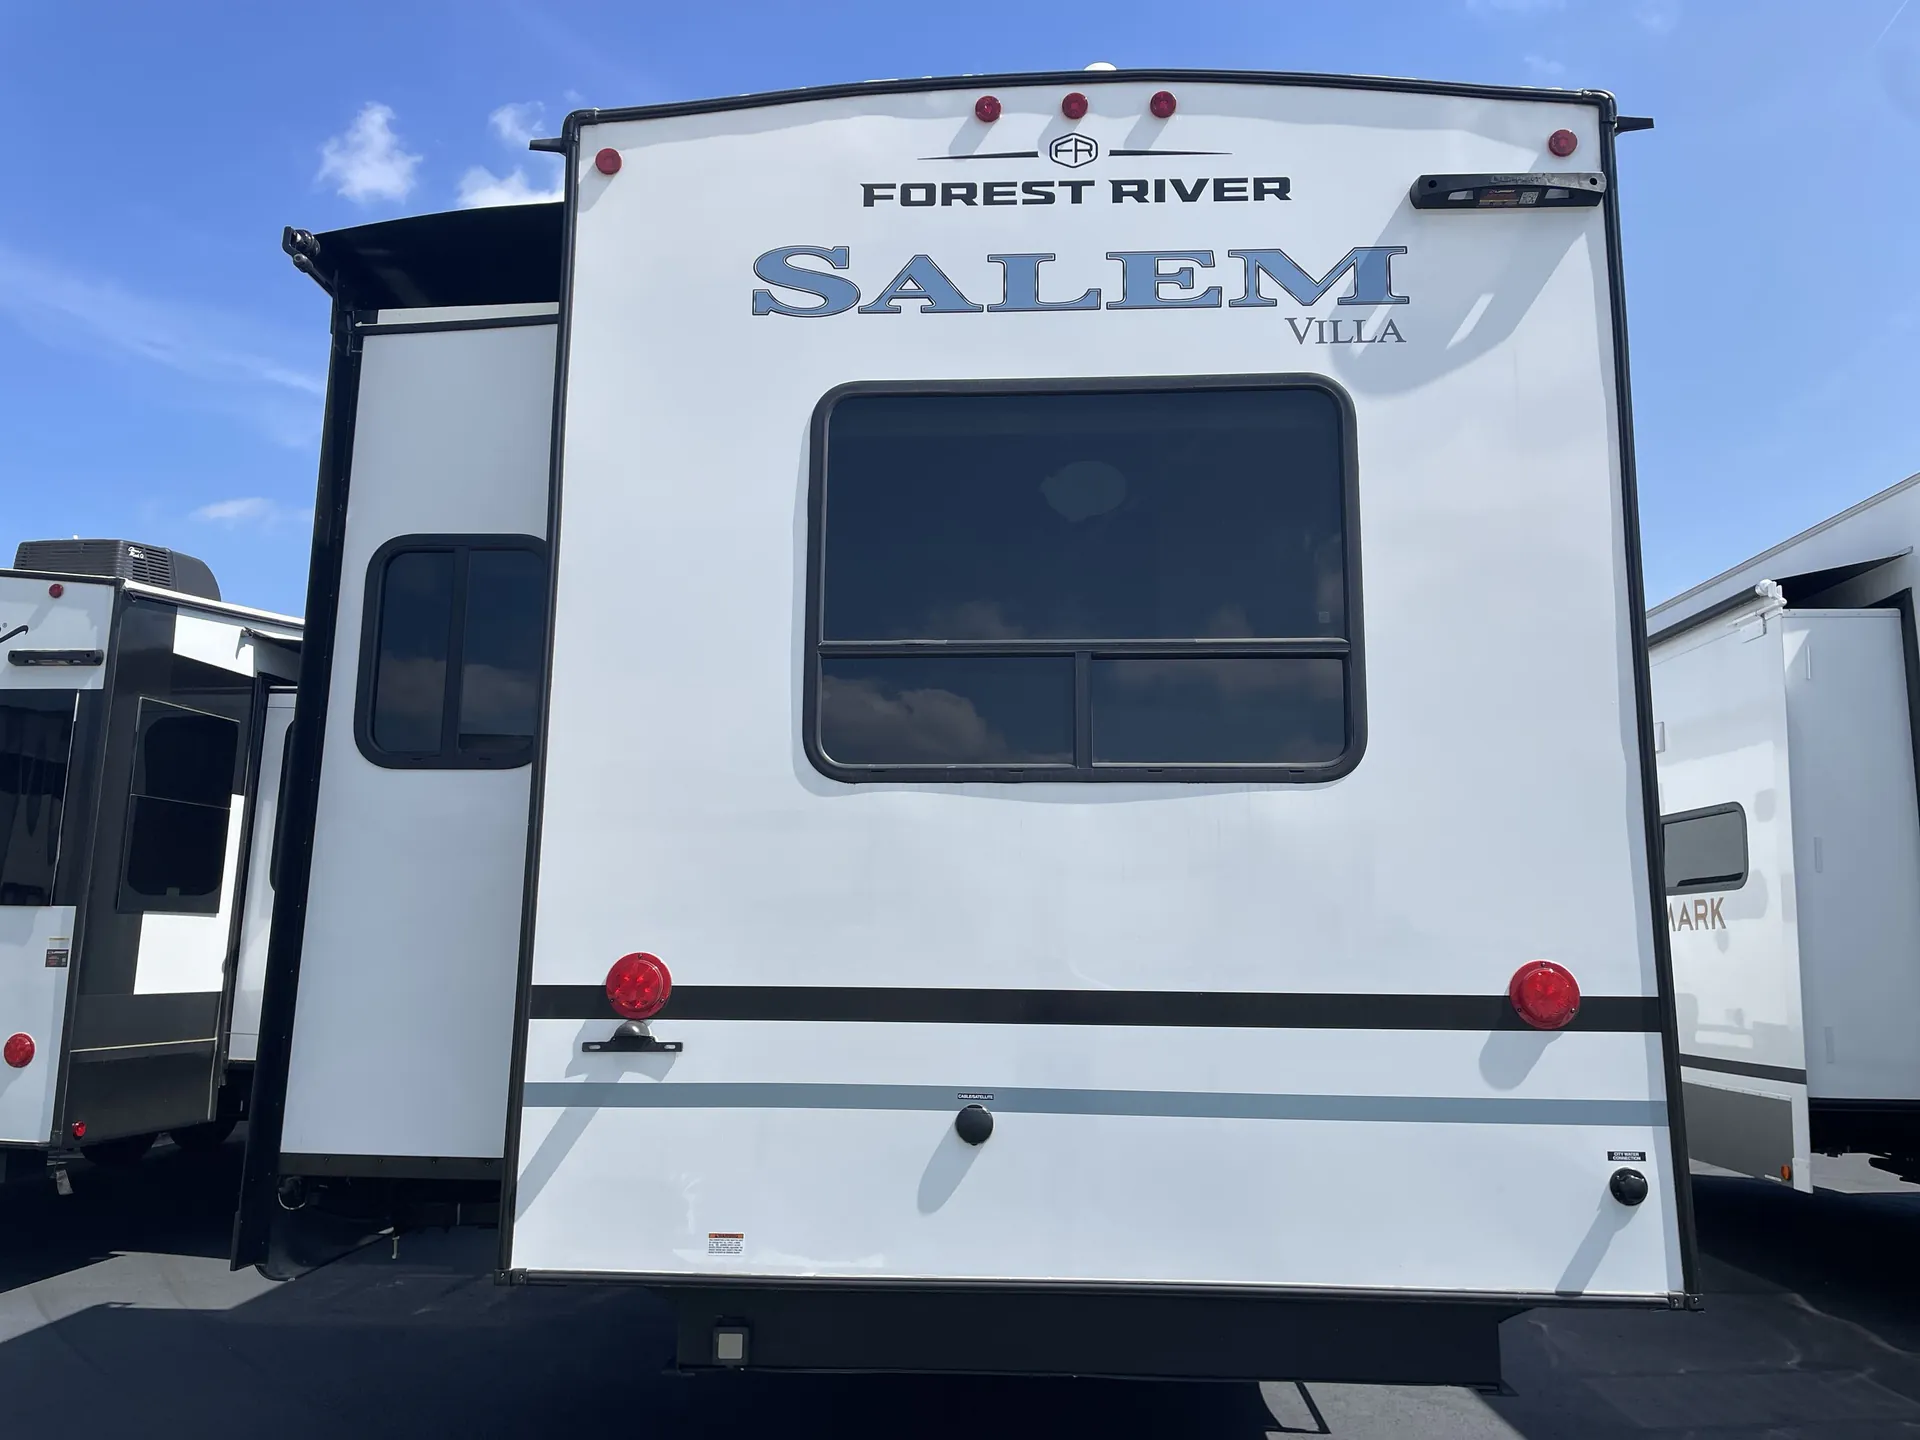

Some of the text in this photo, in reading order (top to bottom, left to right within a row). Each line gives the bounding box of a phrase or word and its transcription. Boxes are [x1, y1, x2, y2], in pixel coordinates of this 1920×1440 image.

[860, 176, 1293, 208] FOREST RIVER
[752, 245, 1411, 318] SALEM
